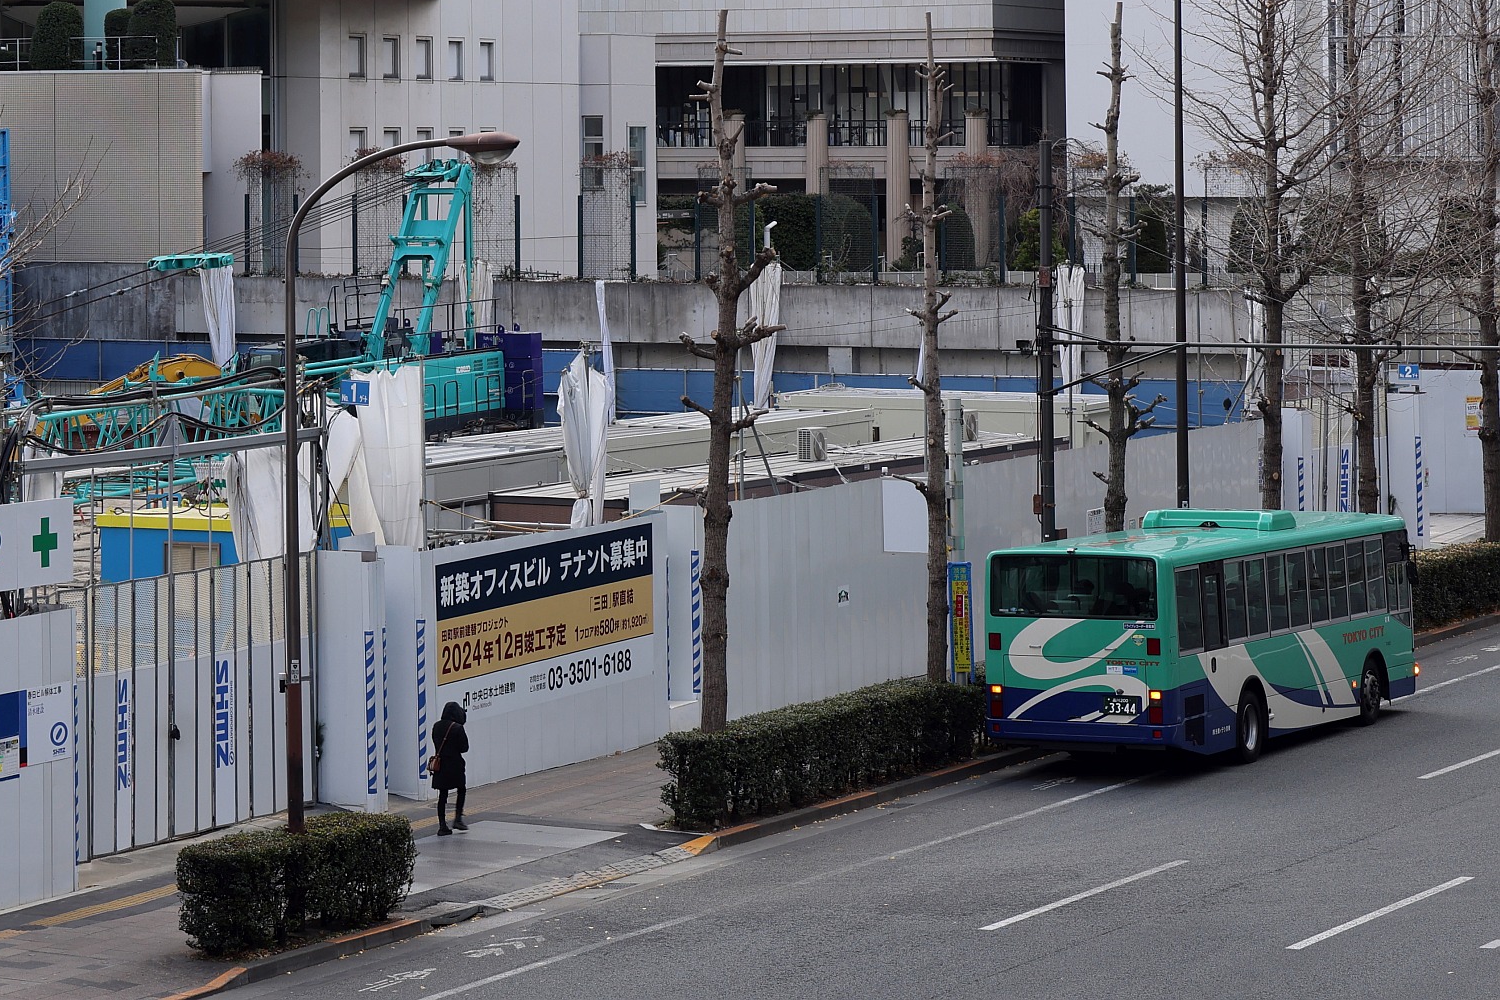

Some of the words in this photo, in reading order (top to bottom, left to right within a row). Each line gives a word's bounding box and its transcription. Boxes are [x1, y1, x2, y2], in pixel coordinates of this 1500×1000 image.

[440, 556, 551, 608] 新築オフィスビル
[559, 535, 649, 582] テナント募集中
[589, 587, 634, 613] 「三田」駅直結
[441, 616, 509, 643] 田町駅前建替プロジェクト
[1342, 629, 1367, 645] TOKYO
[1369, 625, 1384, 640] CITY
[441, 623, 567, 675] 2024年12月竣工予定
[548, 648, 632, 691] 03-3501-6188
[471, 681, 516, 702] 中央日本土地建物
